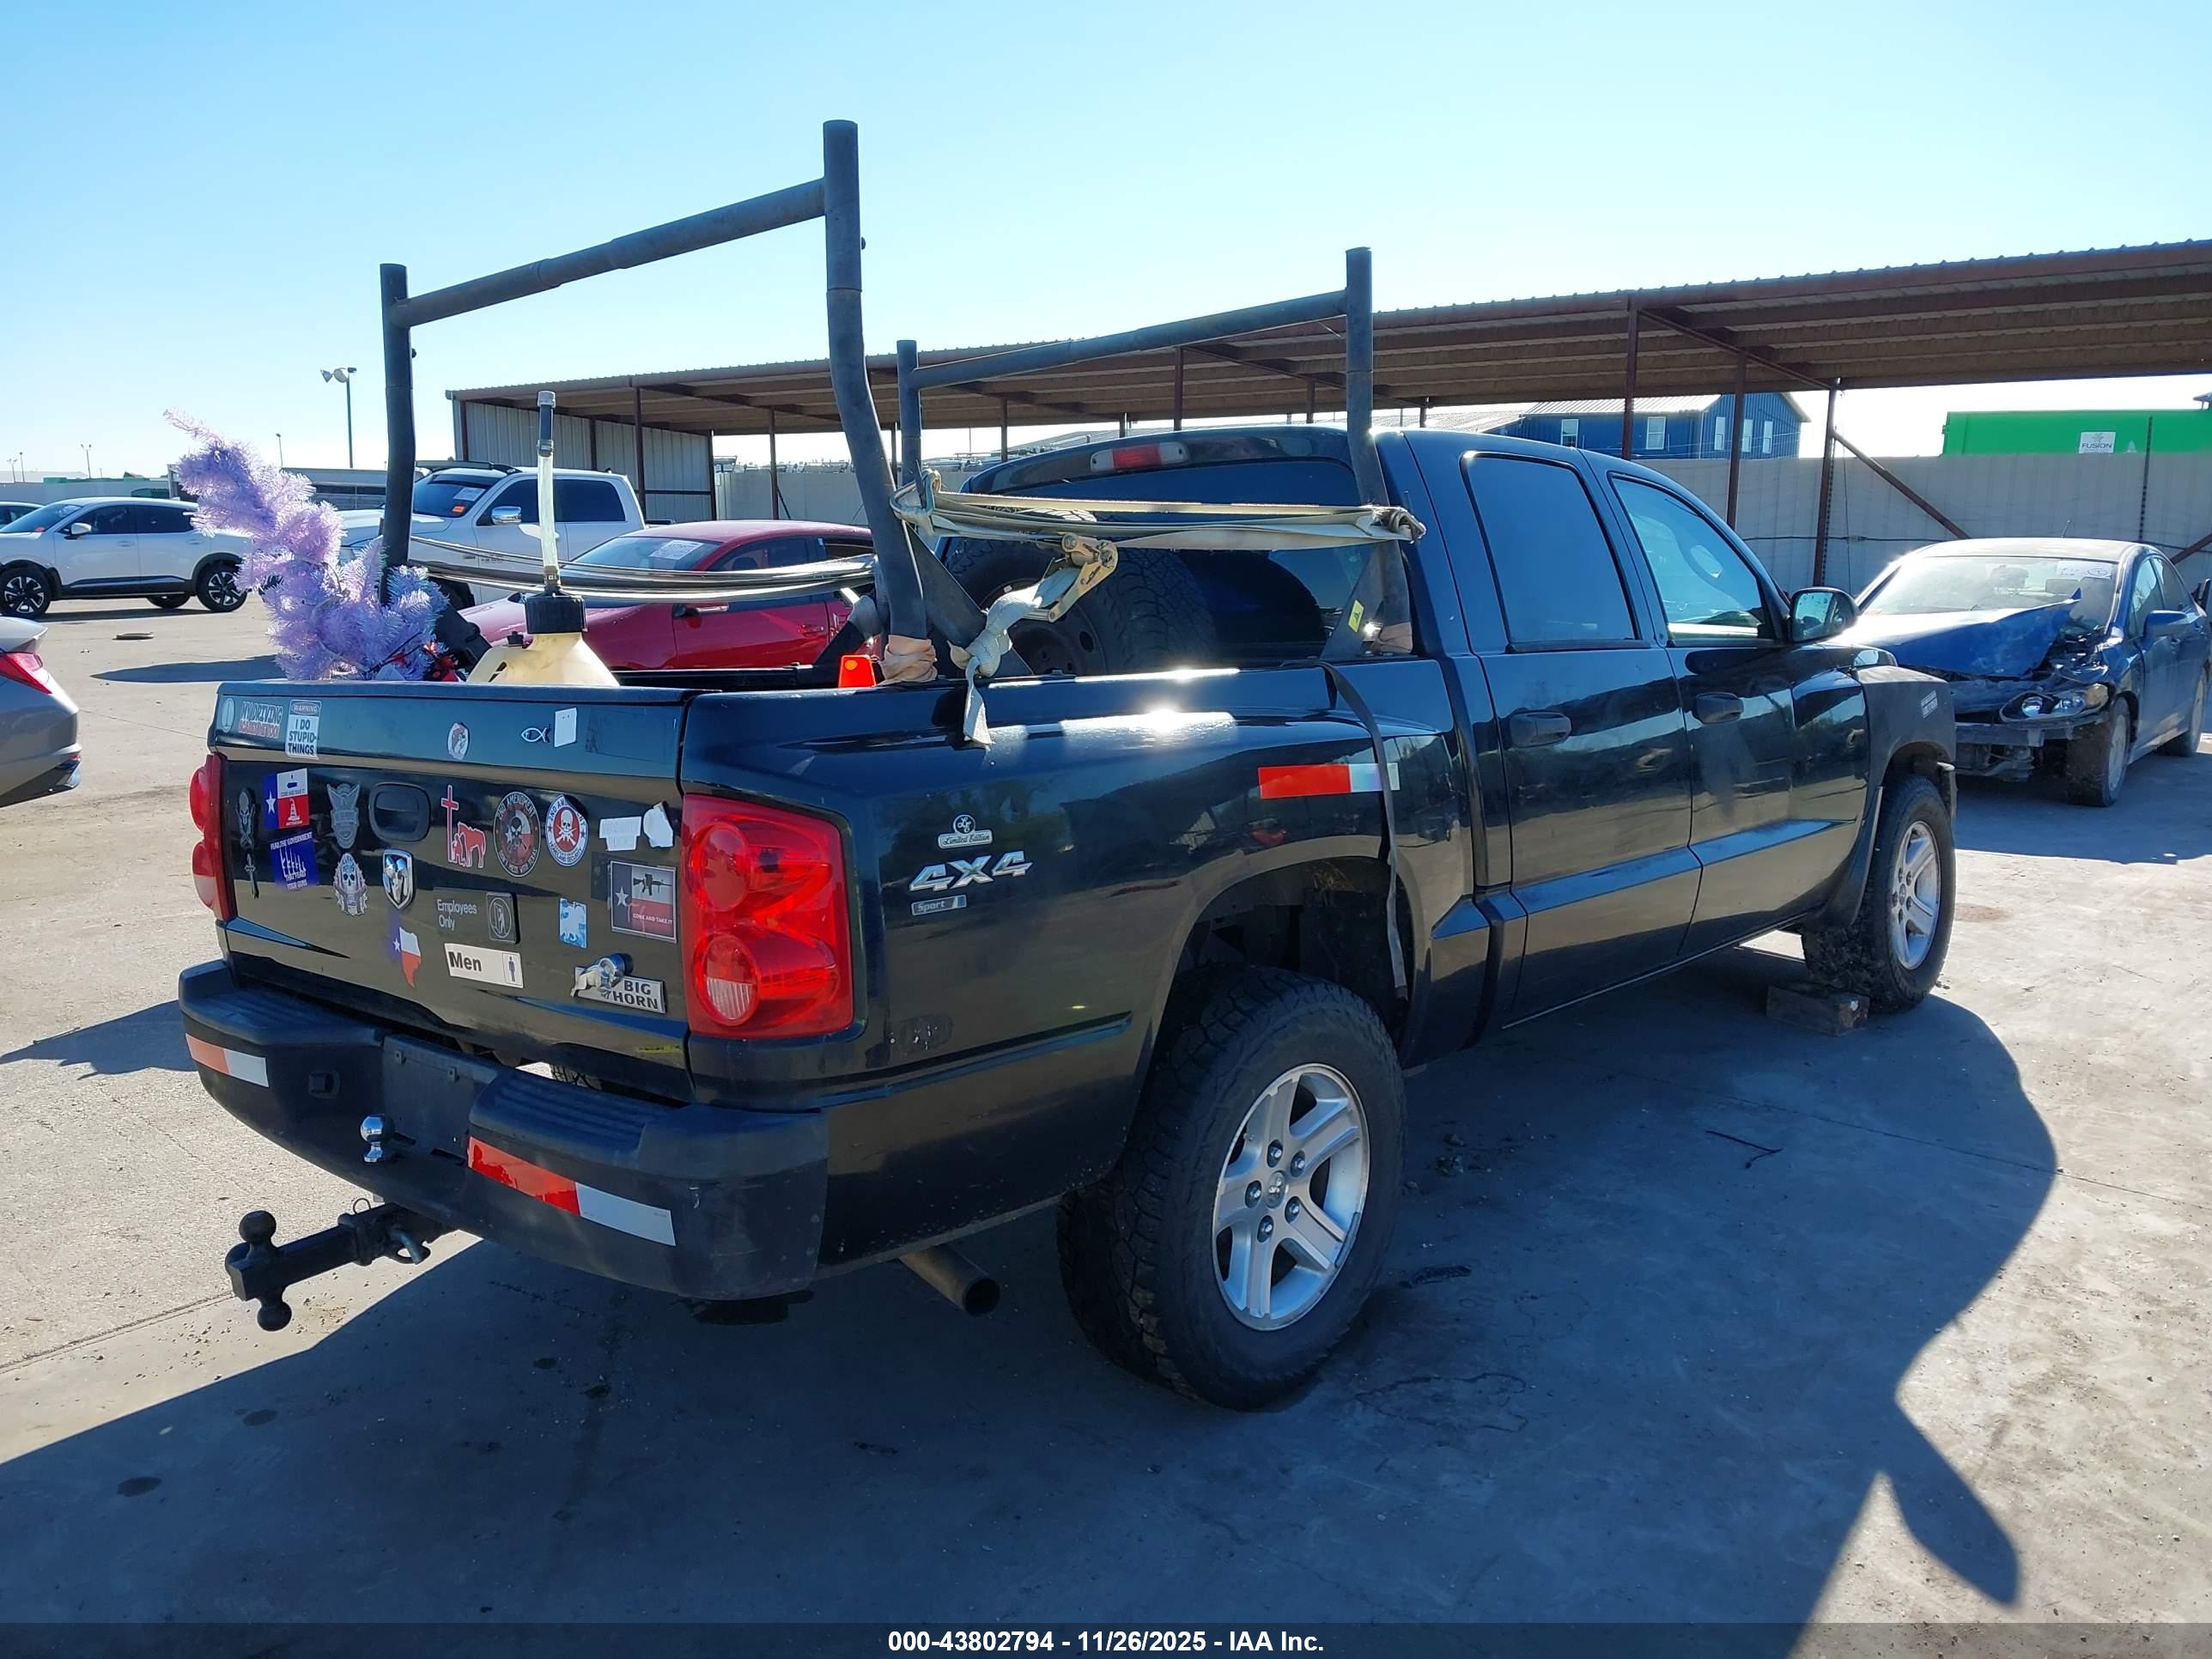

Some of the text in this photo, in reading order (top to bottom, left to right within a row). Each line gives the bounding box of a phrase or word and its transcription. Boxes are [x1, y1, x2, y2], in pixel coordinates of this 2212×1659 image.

[253, 702, 283, 726] DRIVING
[294, 704, 318, 714] WARNING
[295, 719, 311, 730] I DO
[289, 743, 314, 756] THINGS
[507, 793, 536, 817] AMENDMENT
[288, 831, 313, 846] GOVERNMENT
[943, 833, 990, 846] Limited Edition
[436, 899, 477, 915] Employees
[917, 900, 945, 913] Sport
[439, 915, 455, 931] Only
[448, 951, 483, 972] Men
[623, 980, 652, 995] BIG
[612, 990, 659, 1010] HORN
